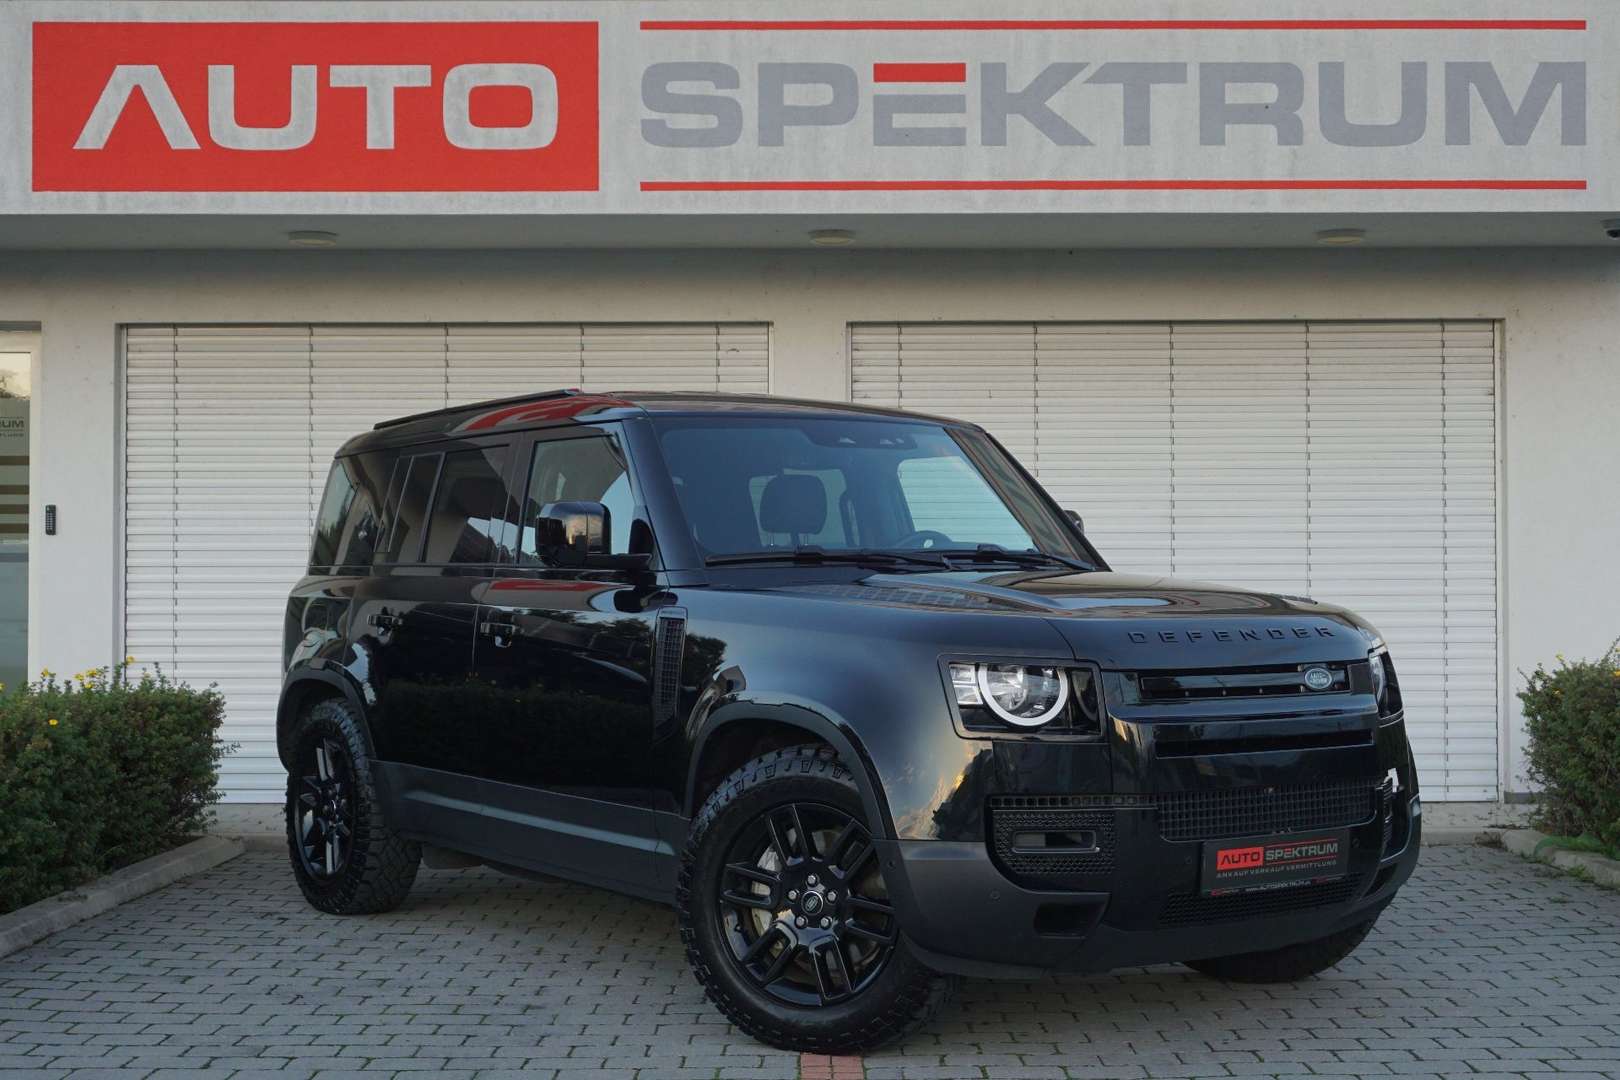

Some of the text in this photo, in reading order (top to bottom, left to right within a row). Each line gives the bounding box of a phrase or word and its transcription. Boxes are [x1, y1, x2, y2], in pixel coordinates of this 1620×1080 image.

[74, 62, 1586, 150] AUTO SPEKTRUM
[1128, 626, 1335, 644] DEFENDER
[1221, 843, 1338, 866] AUTO SPEKTRUM
